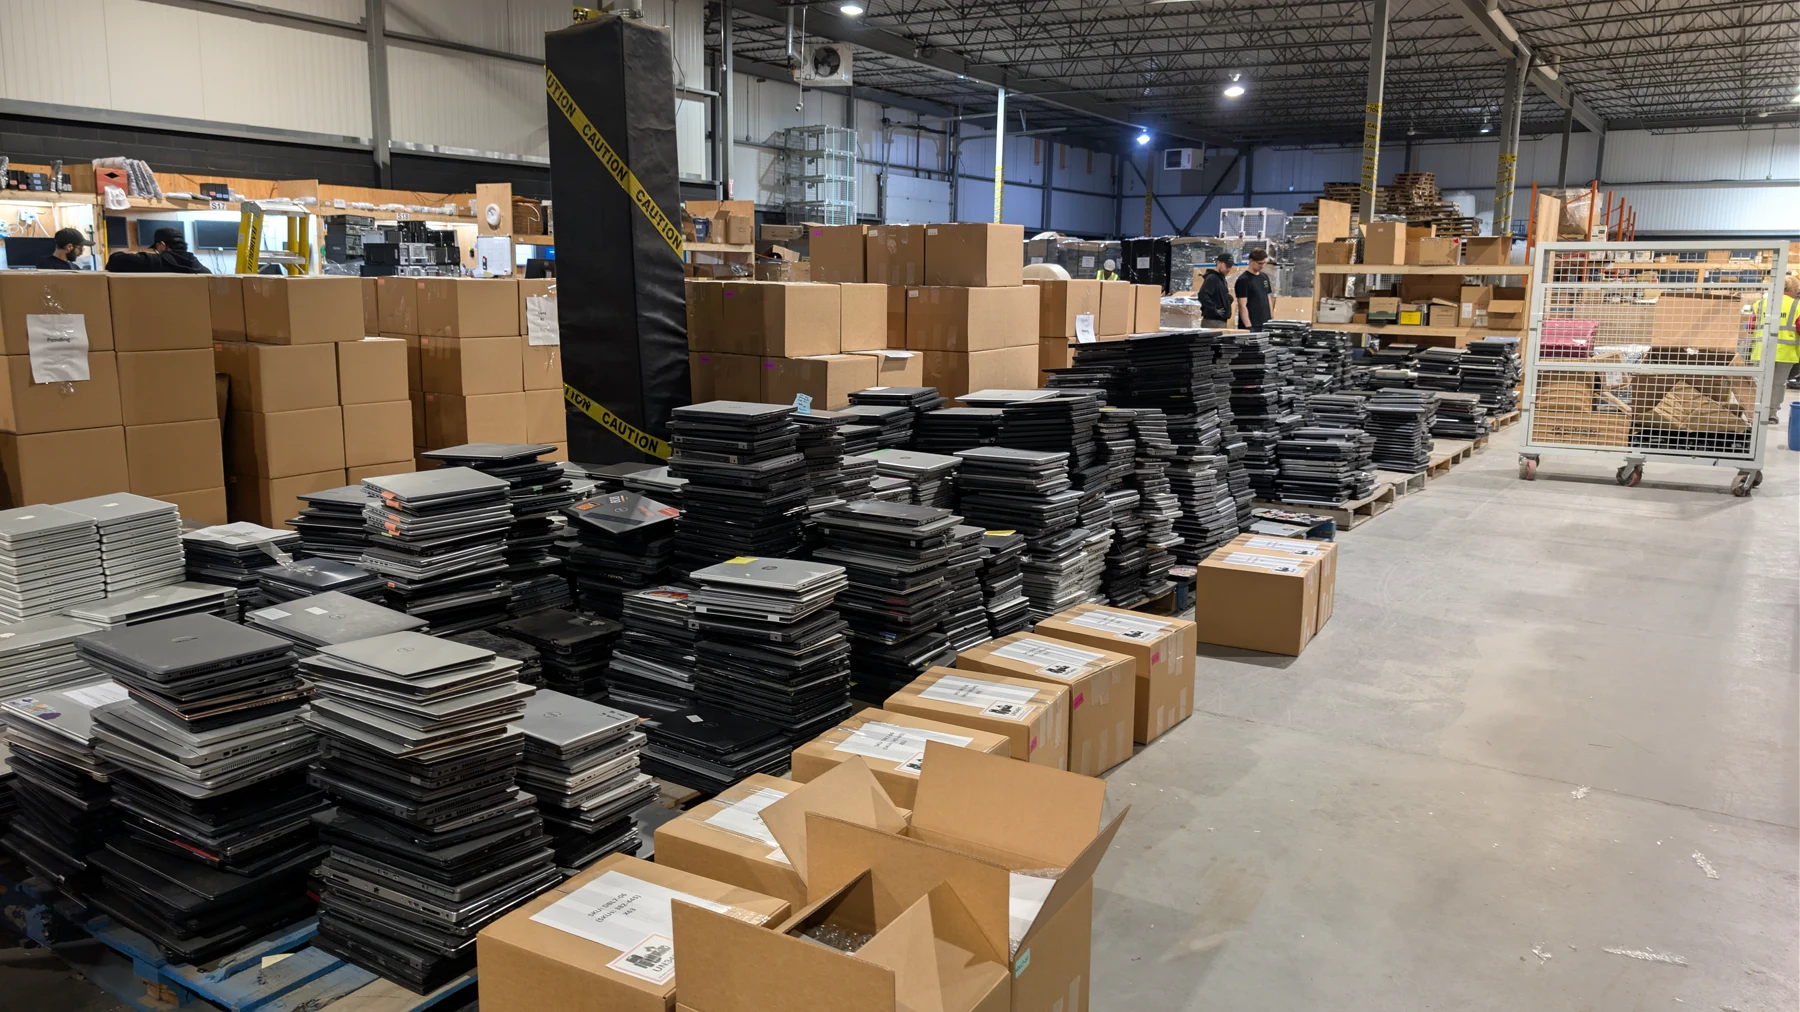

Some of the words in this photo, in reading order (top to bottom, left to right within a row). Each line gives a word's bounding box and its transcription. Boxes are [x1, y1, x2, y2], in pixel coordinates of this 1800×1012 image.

[582, 123, 629, 182] CAUTION
[635, 189, 683, 251] CAUTION
[602, 413, 658, 453] CAUTION
[652, 954, 675, 973] UN34
